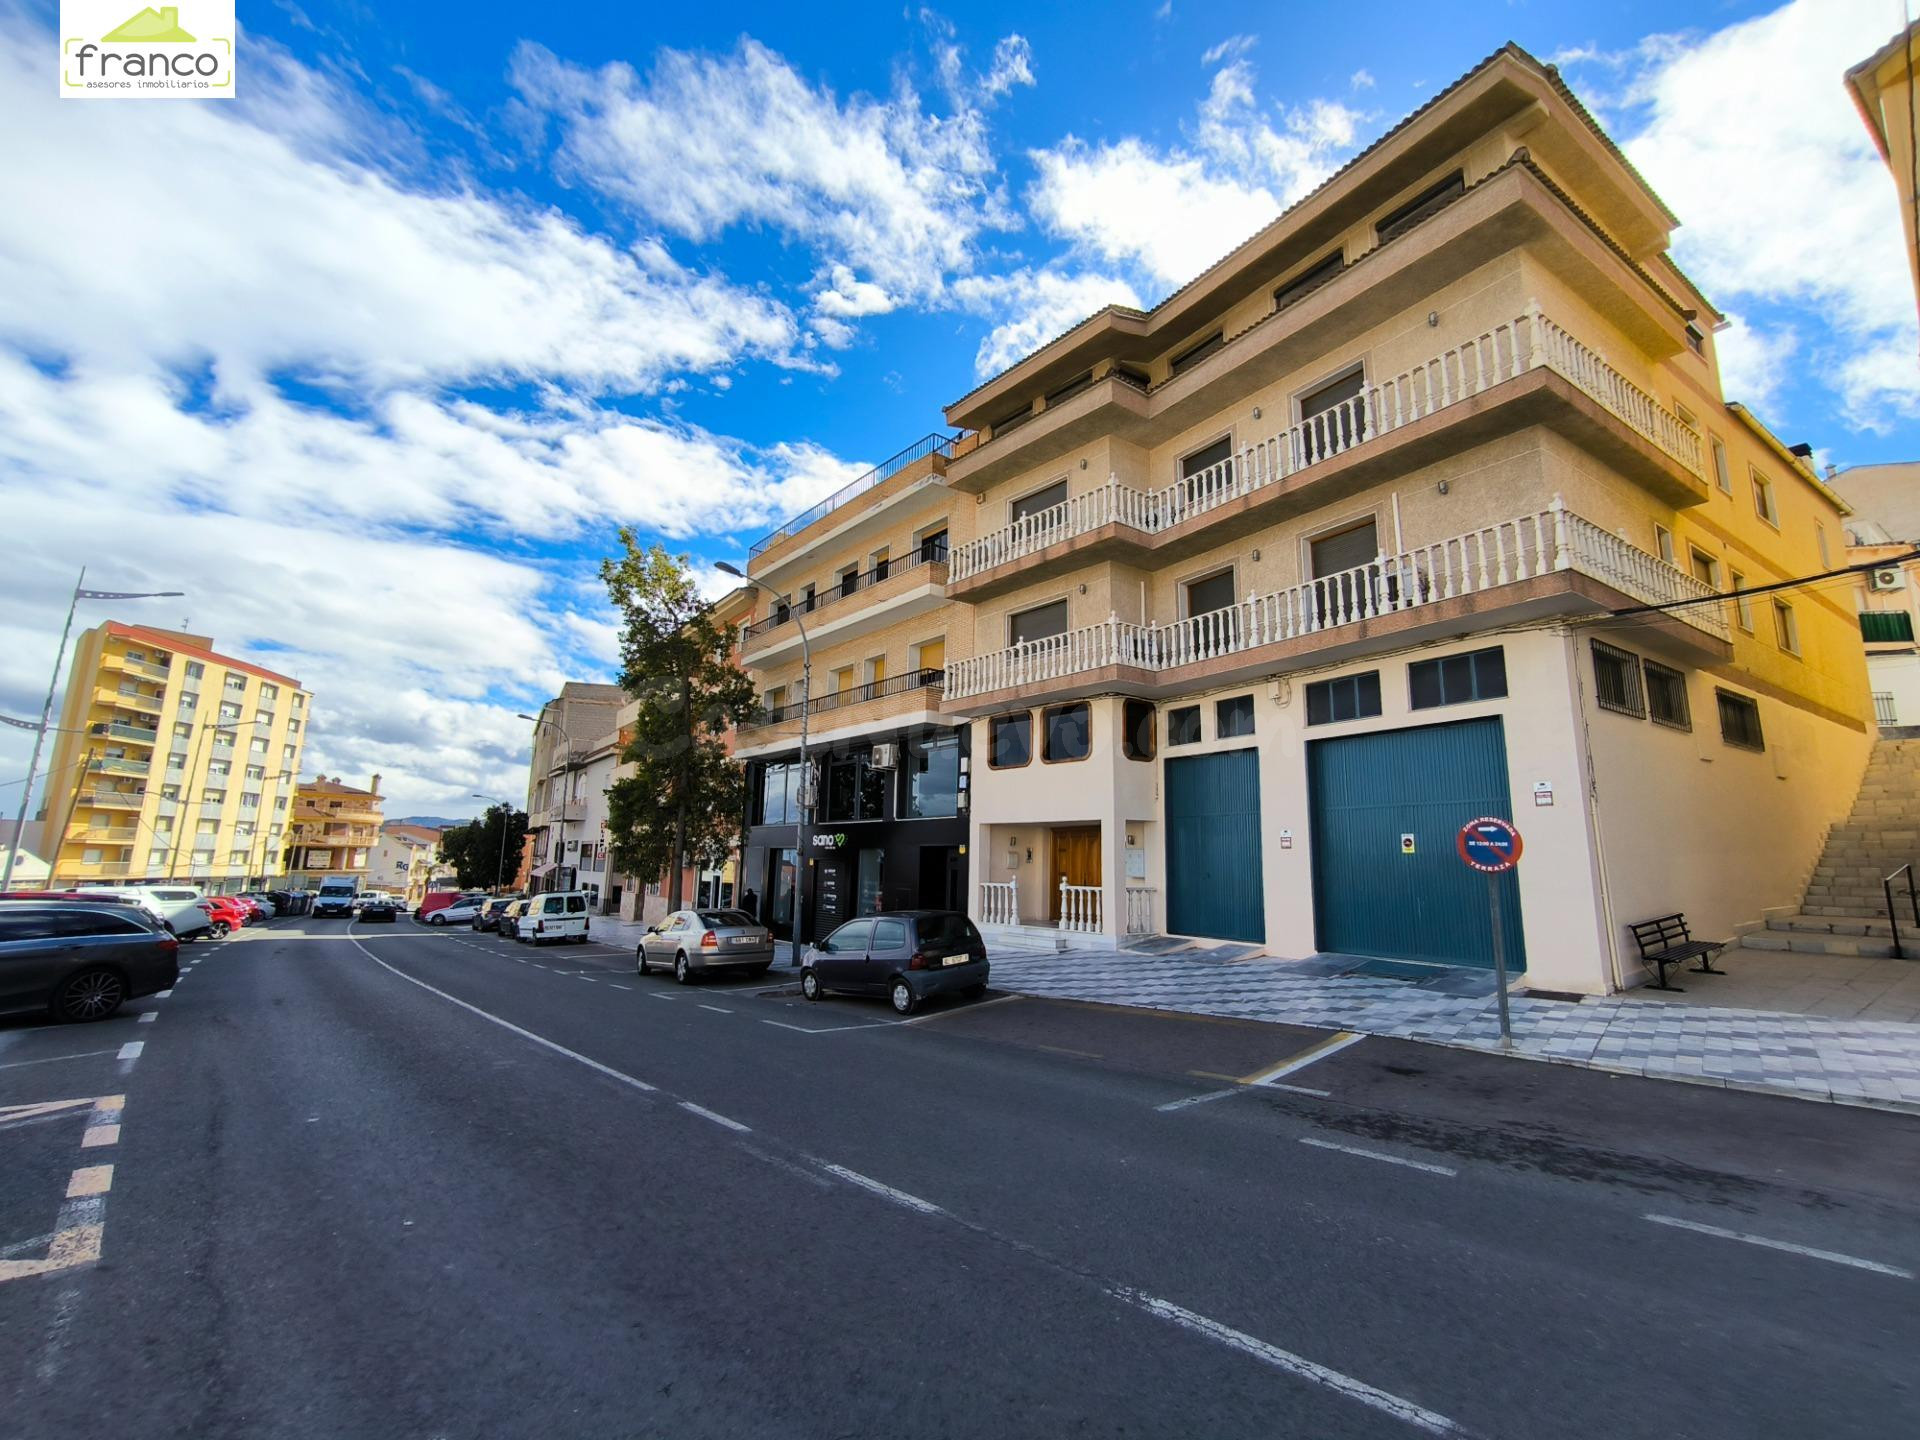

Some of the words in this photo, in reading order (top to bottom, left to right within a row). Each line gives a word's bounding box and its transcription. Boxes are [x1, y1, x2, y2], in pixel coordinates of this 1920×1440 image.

[1480, 816, 1516, 837] RESERVADA
[812, 834, 834, 847] sano
[395, 860, 410, 871] RG
[1470, 860, 1511, 872] TERRAZA
